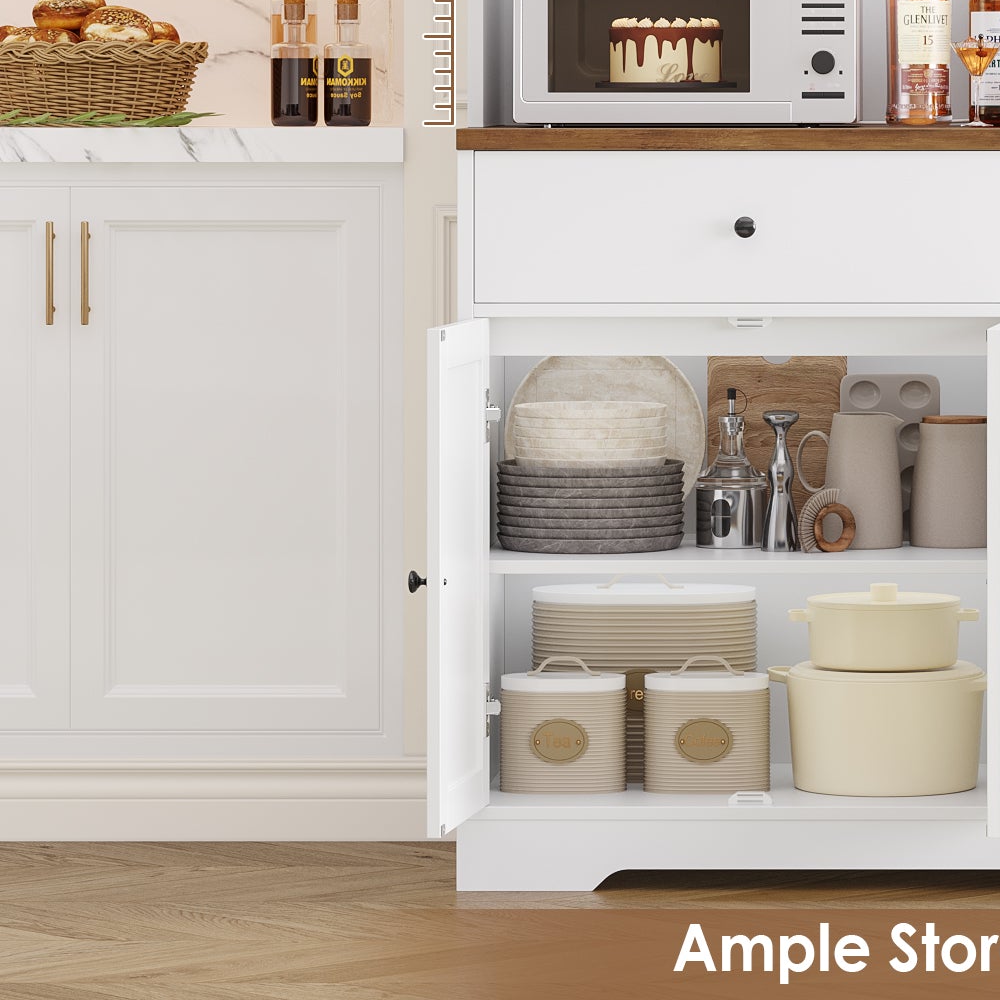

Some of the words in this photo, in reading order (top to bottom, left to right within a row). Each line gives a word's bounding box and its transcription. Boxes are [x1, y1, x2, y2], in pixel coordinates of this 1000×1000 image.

[920, 5, 936, 14] THE
[903, 14, 949, 26] GLENLIVET
[922, 35, 934, 46] 15
[543, 733, 571, 749] Tea
